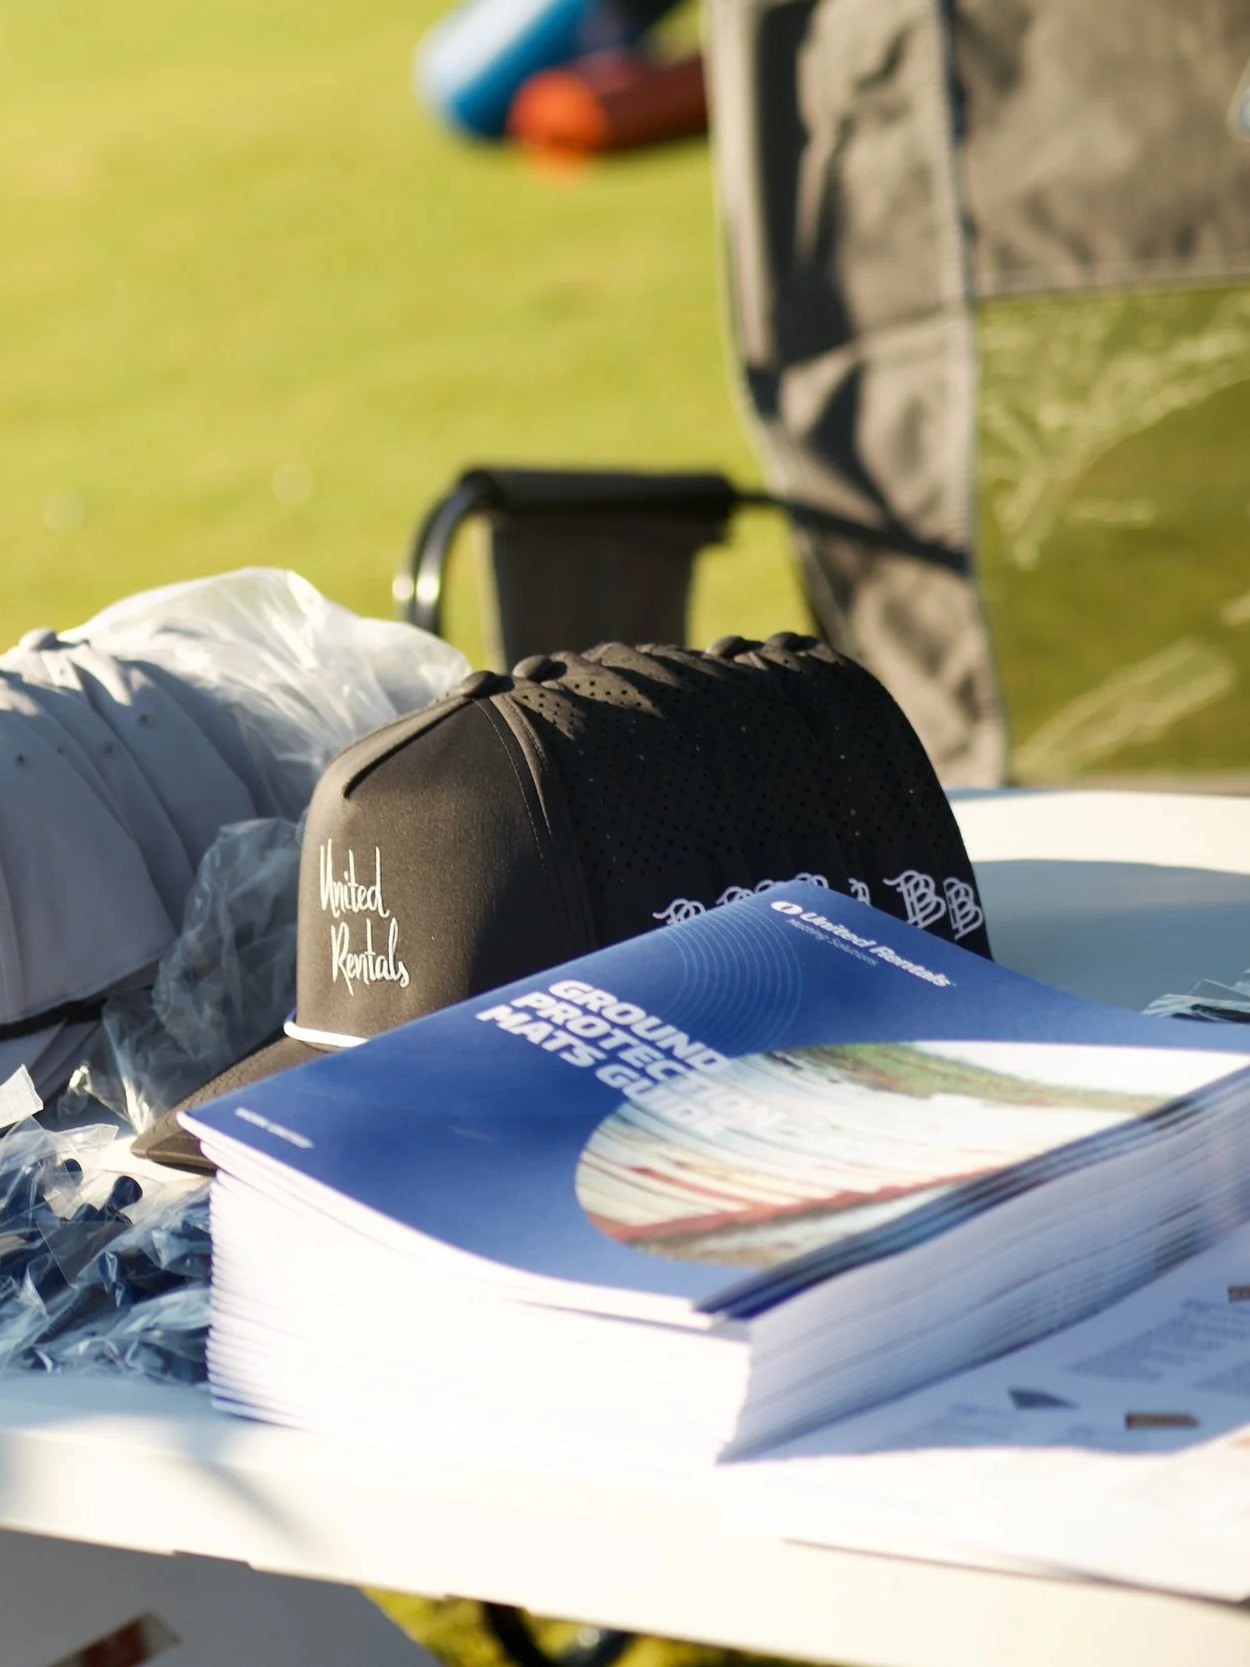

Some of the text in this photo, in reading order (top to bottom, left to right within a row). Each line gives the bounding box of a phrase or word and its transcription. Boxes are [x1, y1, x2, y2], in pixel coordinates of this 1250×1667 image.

[319, 838, 390, 919] United
[330, 917, 410, 996] Rentals
[800, 911, 953, 988] United Rentals
[475, 1003, 607, 1068] MATS
[510, 991, 788, 1128] PROTECTION
[548, 980, 732, 1074] GROUND
